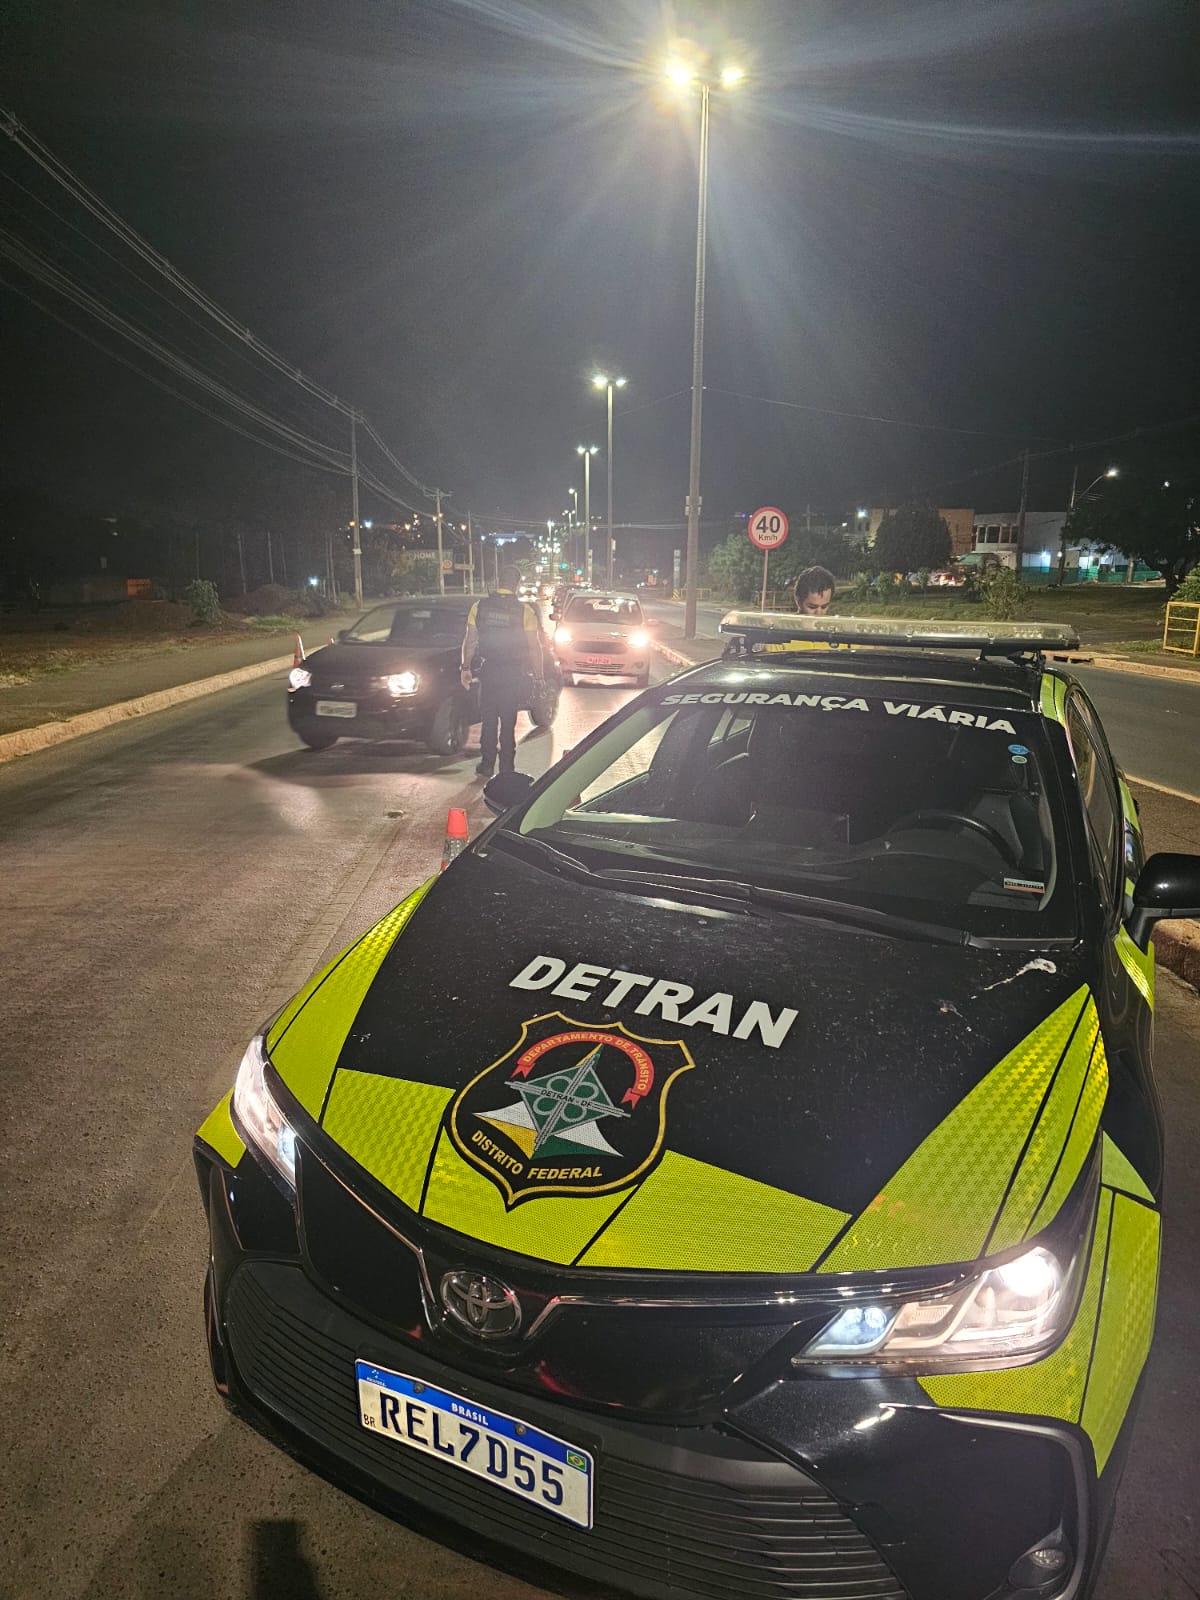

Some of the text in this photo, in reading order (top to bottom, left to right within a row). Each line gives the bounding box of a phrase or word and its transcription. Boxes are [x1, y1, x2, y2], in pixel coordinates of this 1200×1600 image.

[756, 515, 780, 533] 40
[660, 693, 1017, 735] SEGURANÇA VIÁRIA
[509, 955, 799, 1048] DETRAN
[523, 1033, 613, 1063] DEPARTAMENTO
[615, 1039, 630, 1049] DE
[471, 1130, 603, 1180] DISTRITO FEDERAL
[363, 1413, 376, 1428] BR
[451, 1402, 489, 1426] BRASIL
[379, 1391, 564, 1506] REL7D55
